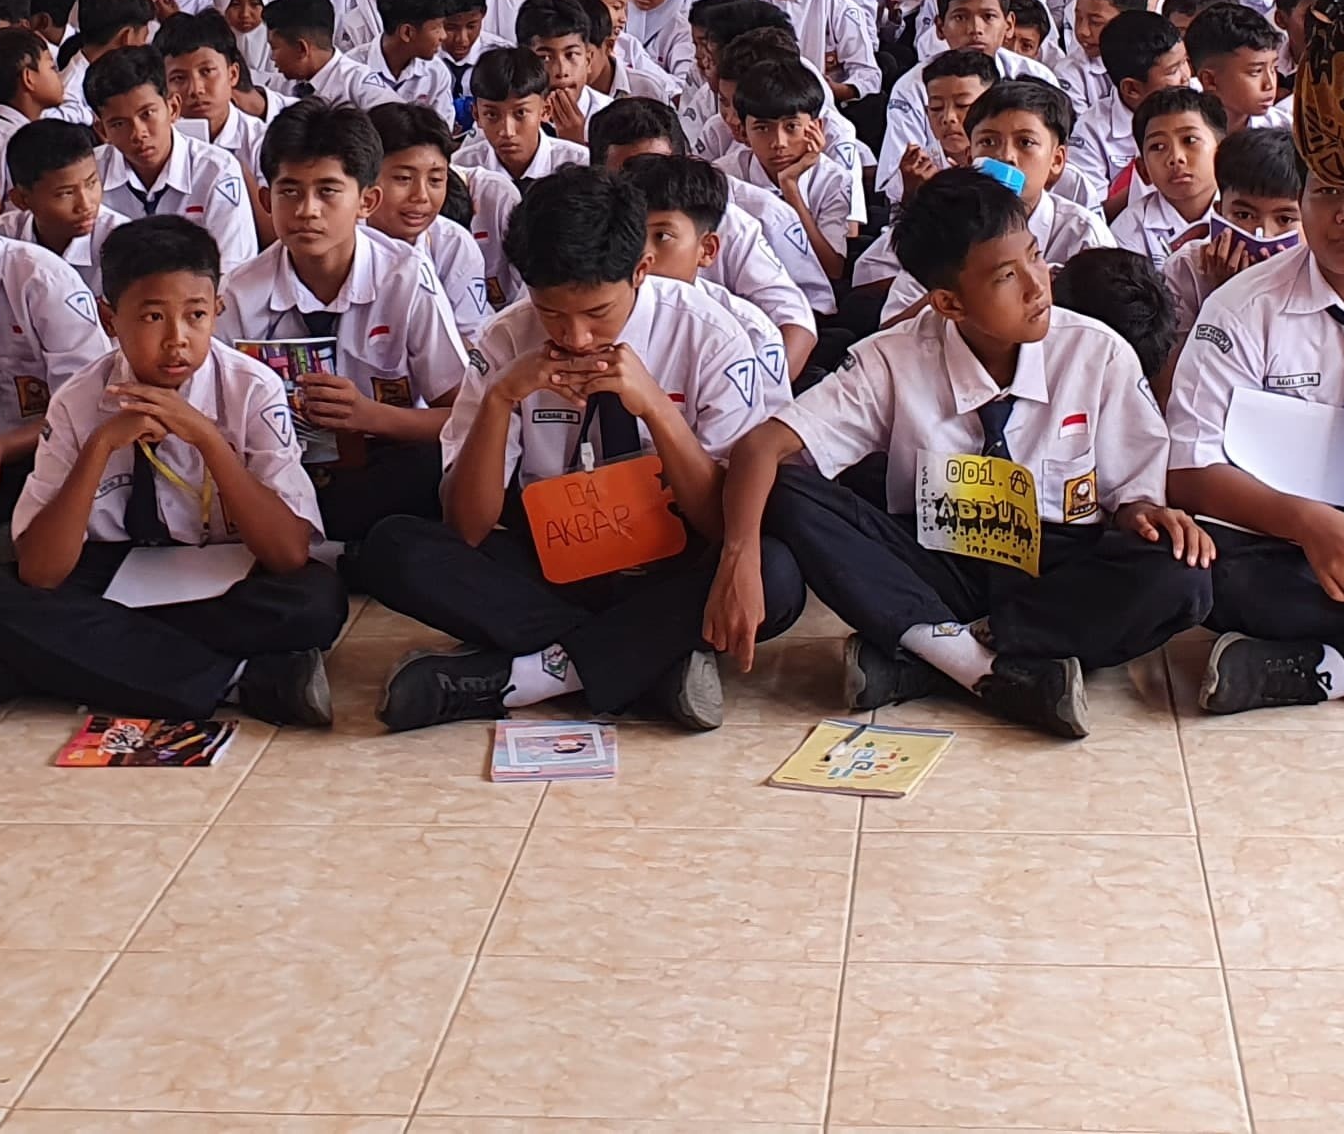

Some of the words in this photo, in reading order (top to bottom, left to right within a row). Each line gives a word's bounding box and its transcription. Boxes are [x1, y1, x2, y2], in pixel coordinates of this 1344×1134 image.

[766, 350, 779, 373] 7
[738, 366, 749, 392] 7
[273, 411, 287, 435] 7
[936, 492, 1030, 534] ABDUR
[544, 505, 634, 548] AKBAR
